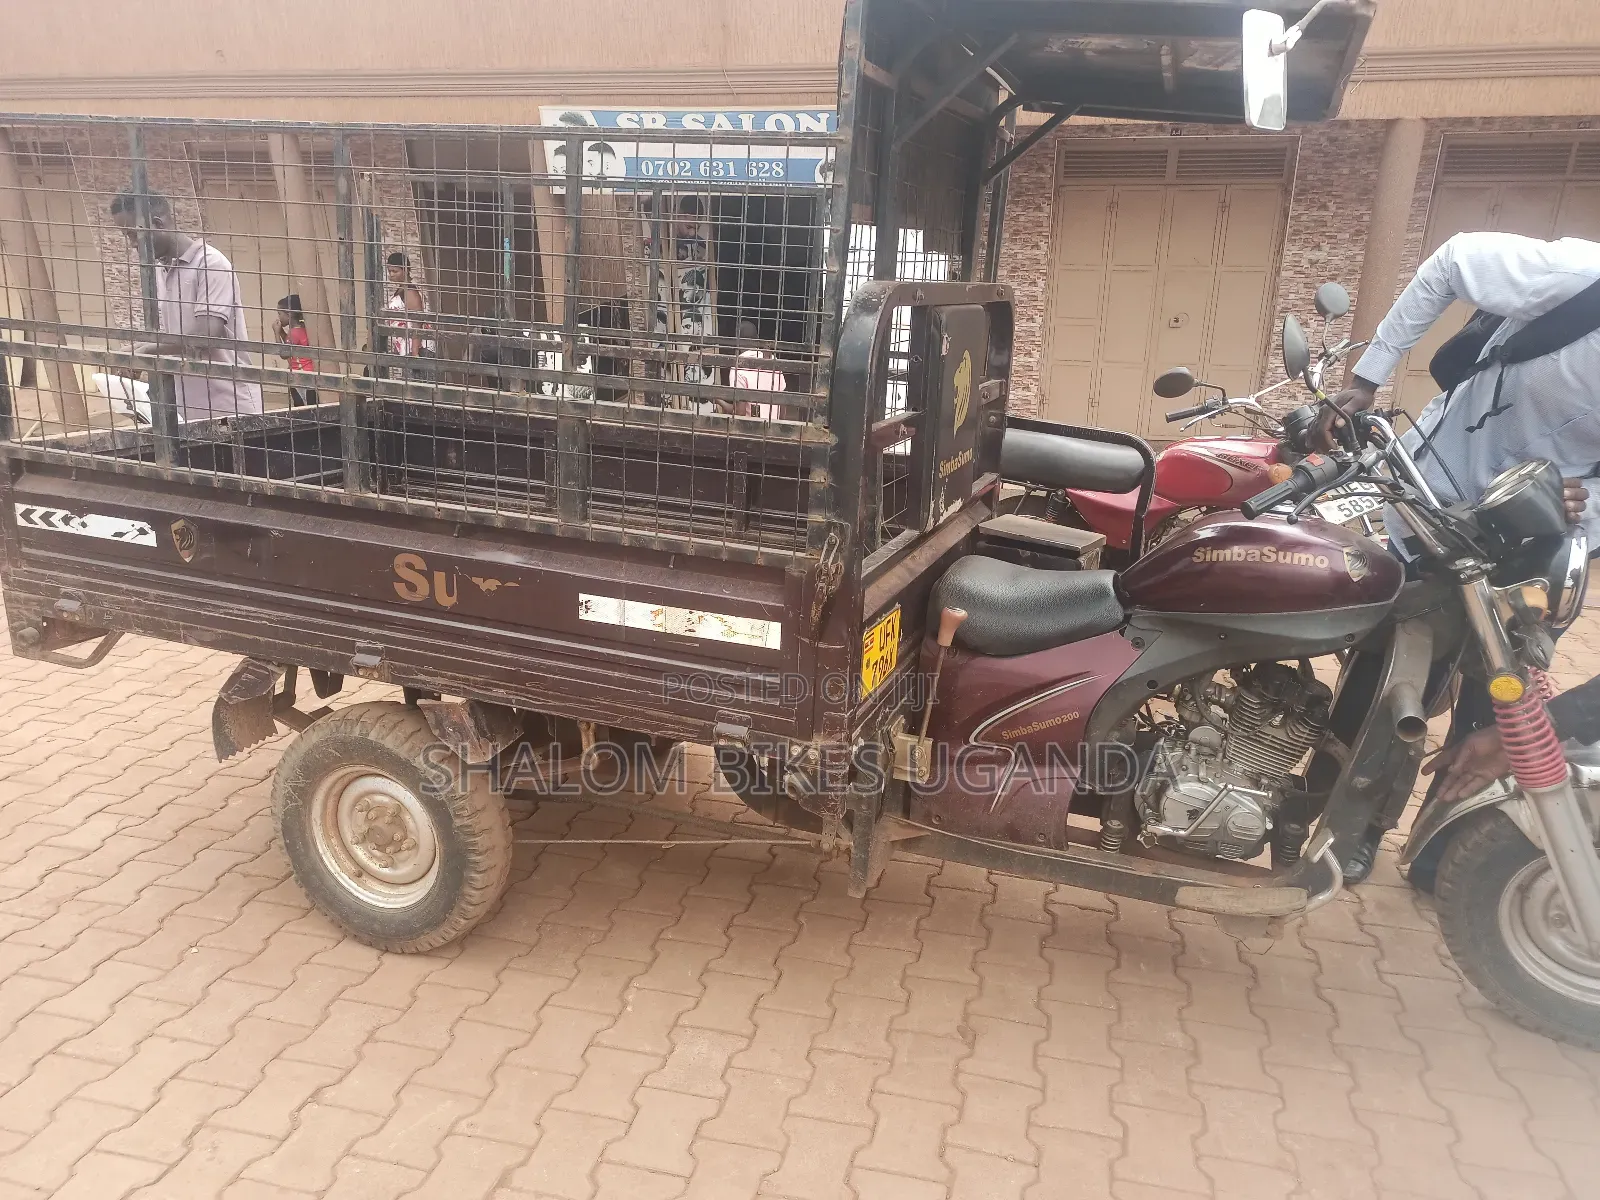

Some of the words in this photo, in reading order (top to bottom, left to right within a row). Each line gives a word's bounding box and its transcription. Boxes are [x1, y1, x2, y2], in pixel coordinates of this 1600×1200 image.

[641, 160, 692, 176] 0702
[699, 160, 737, 177] 631
[745, 161, 784, 177] 628
[1192, 546, 1330, 569] SimbaSumo
